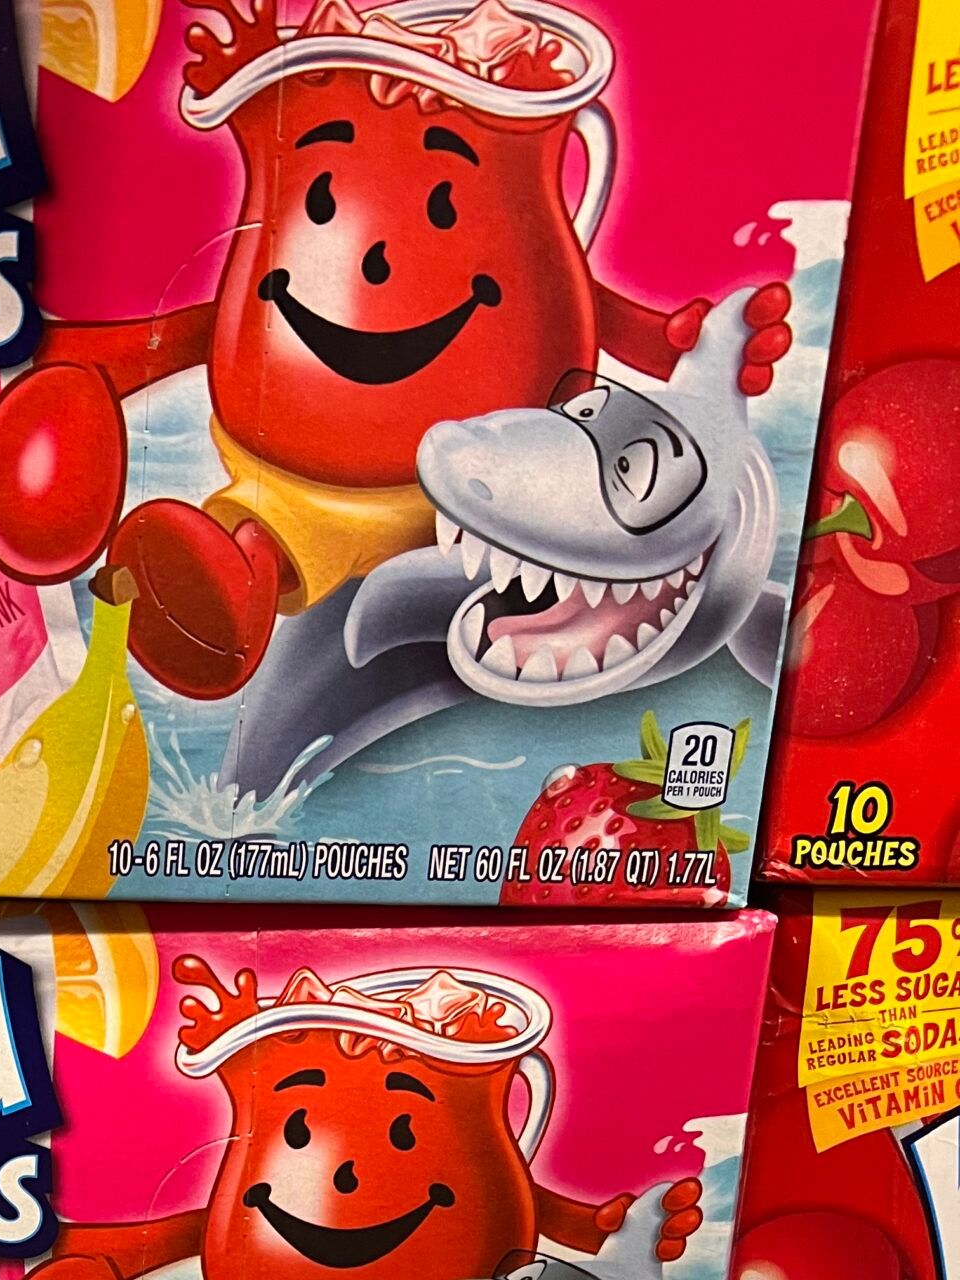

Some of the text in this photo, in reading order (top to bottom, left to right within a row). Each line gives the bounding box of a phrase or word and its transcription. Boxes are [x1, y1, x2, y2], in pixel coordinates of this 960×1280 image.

[682, 734, 717, 767] 20
[668, 770, 724, 784] CALORIES
[830, 785, 891, 835] 10
[164, 843, 408, 879] FL OZ POUCHES
[430, 847, 716, 885] NET 60 FL OZ QT) 1.77L
[793, 836, 918, 870] POUCHES
[816, 980, 887, 1012] LESS
[879, 1006, 918, 1024] THAN
